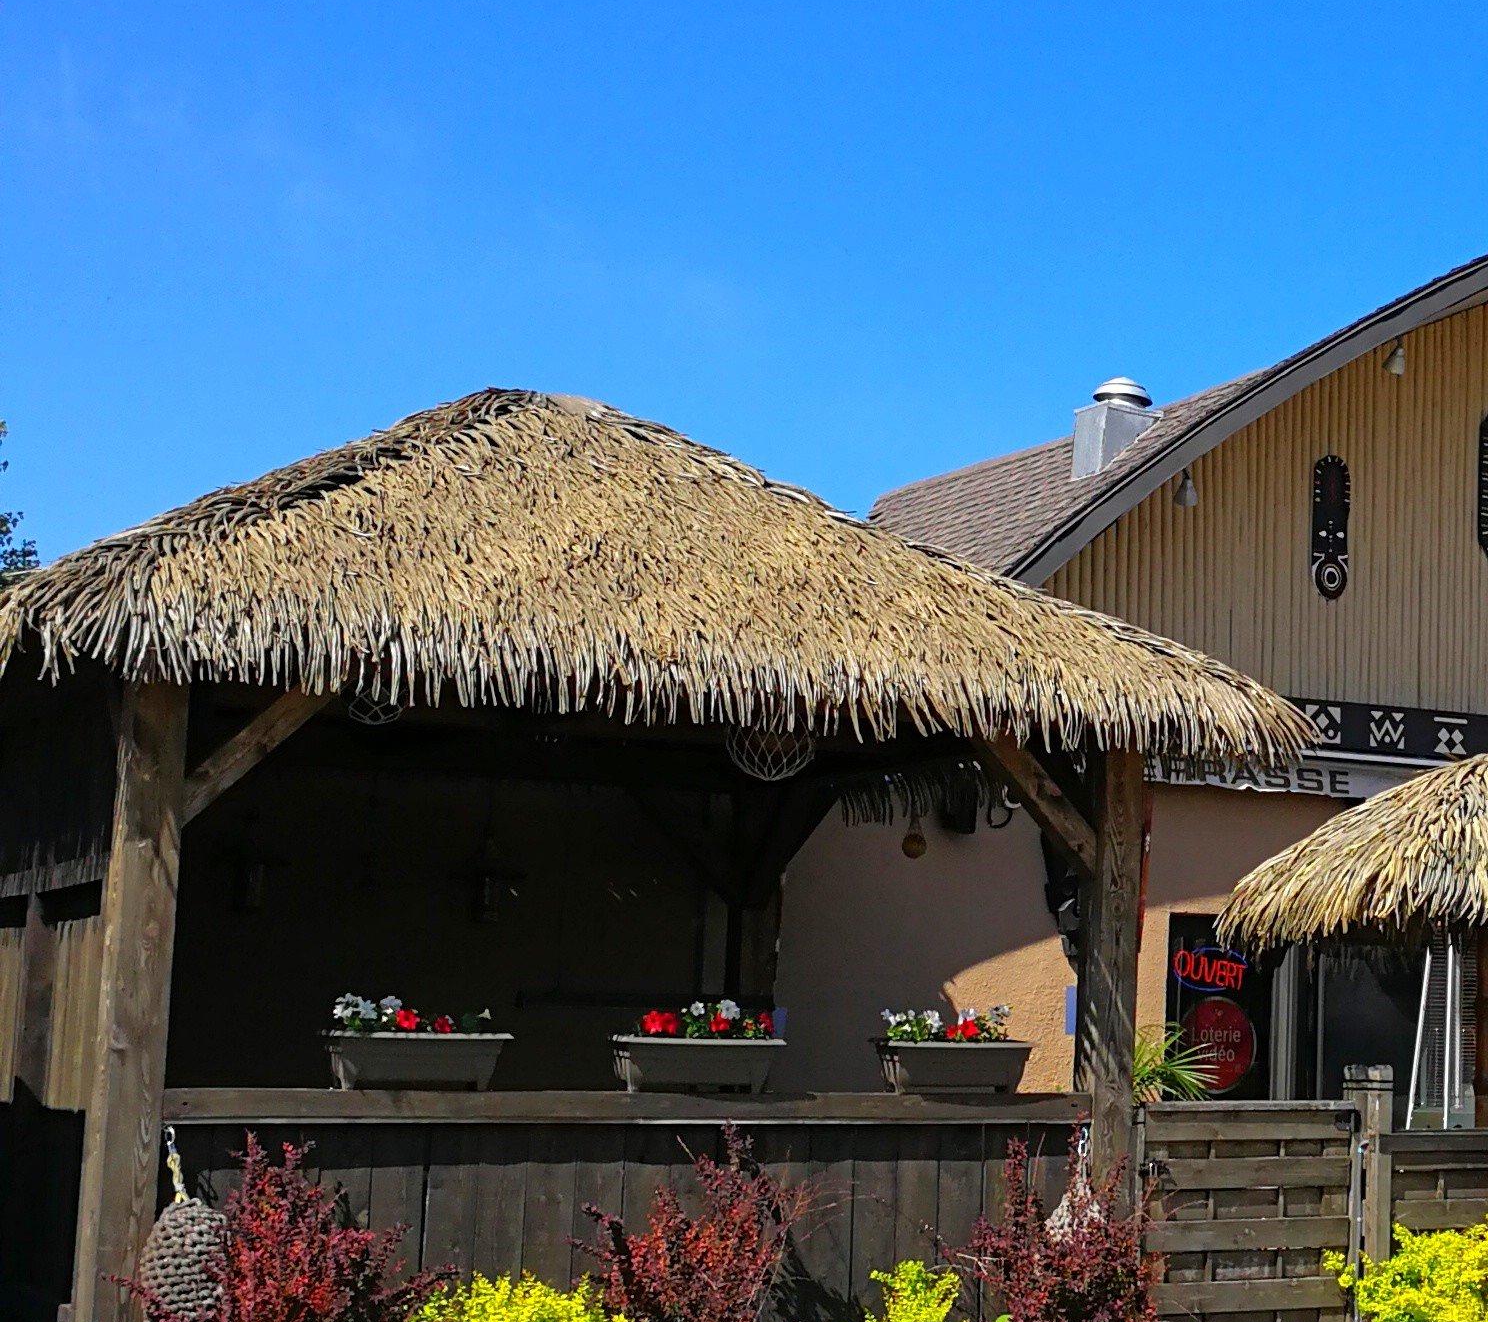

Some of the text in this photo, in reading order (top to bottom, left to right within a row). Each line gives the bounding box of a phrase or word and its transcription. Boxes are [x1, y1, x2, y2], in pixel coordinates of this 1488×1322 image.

[1173, 949, 1246, 991] OUVERT
[1191, 1026, 1242, 1043] Loterie
[1196, 1045, 1236, 1062] vidéo
